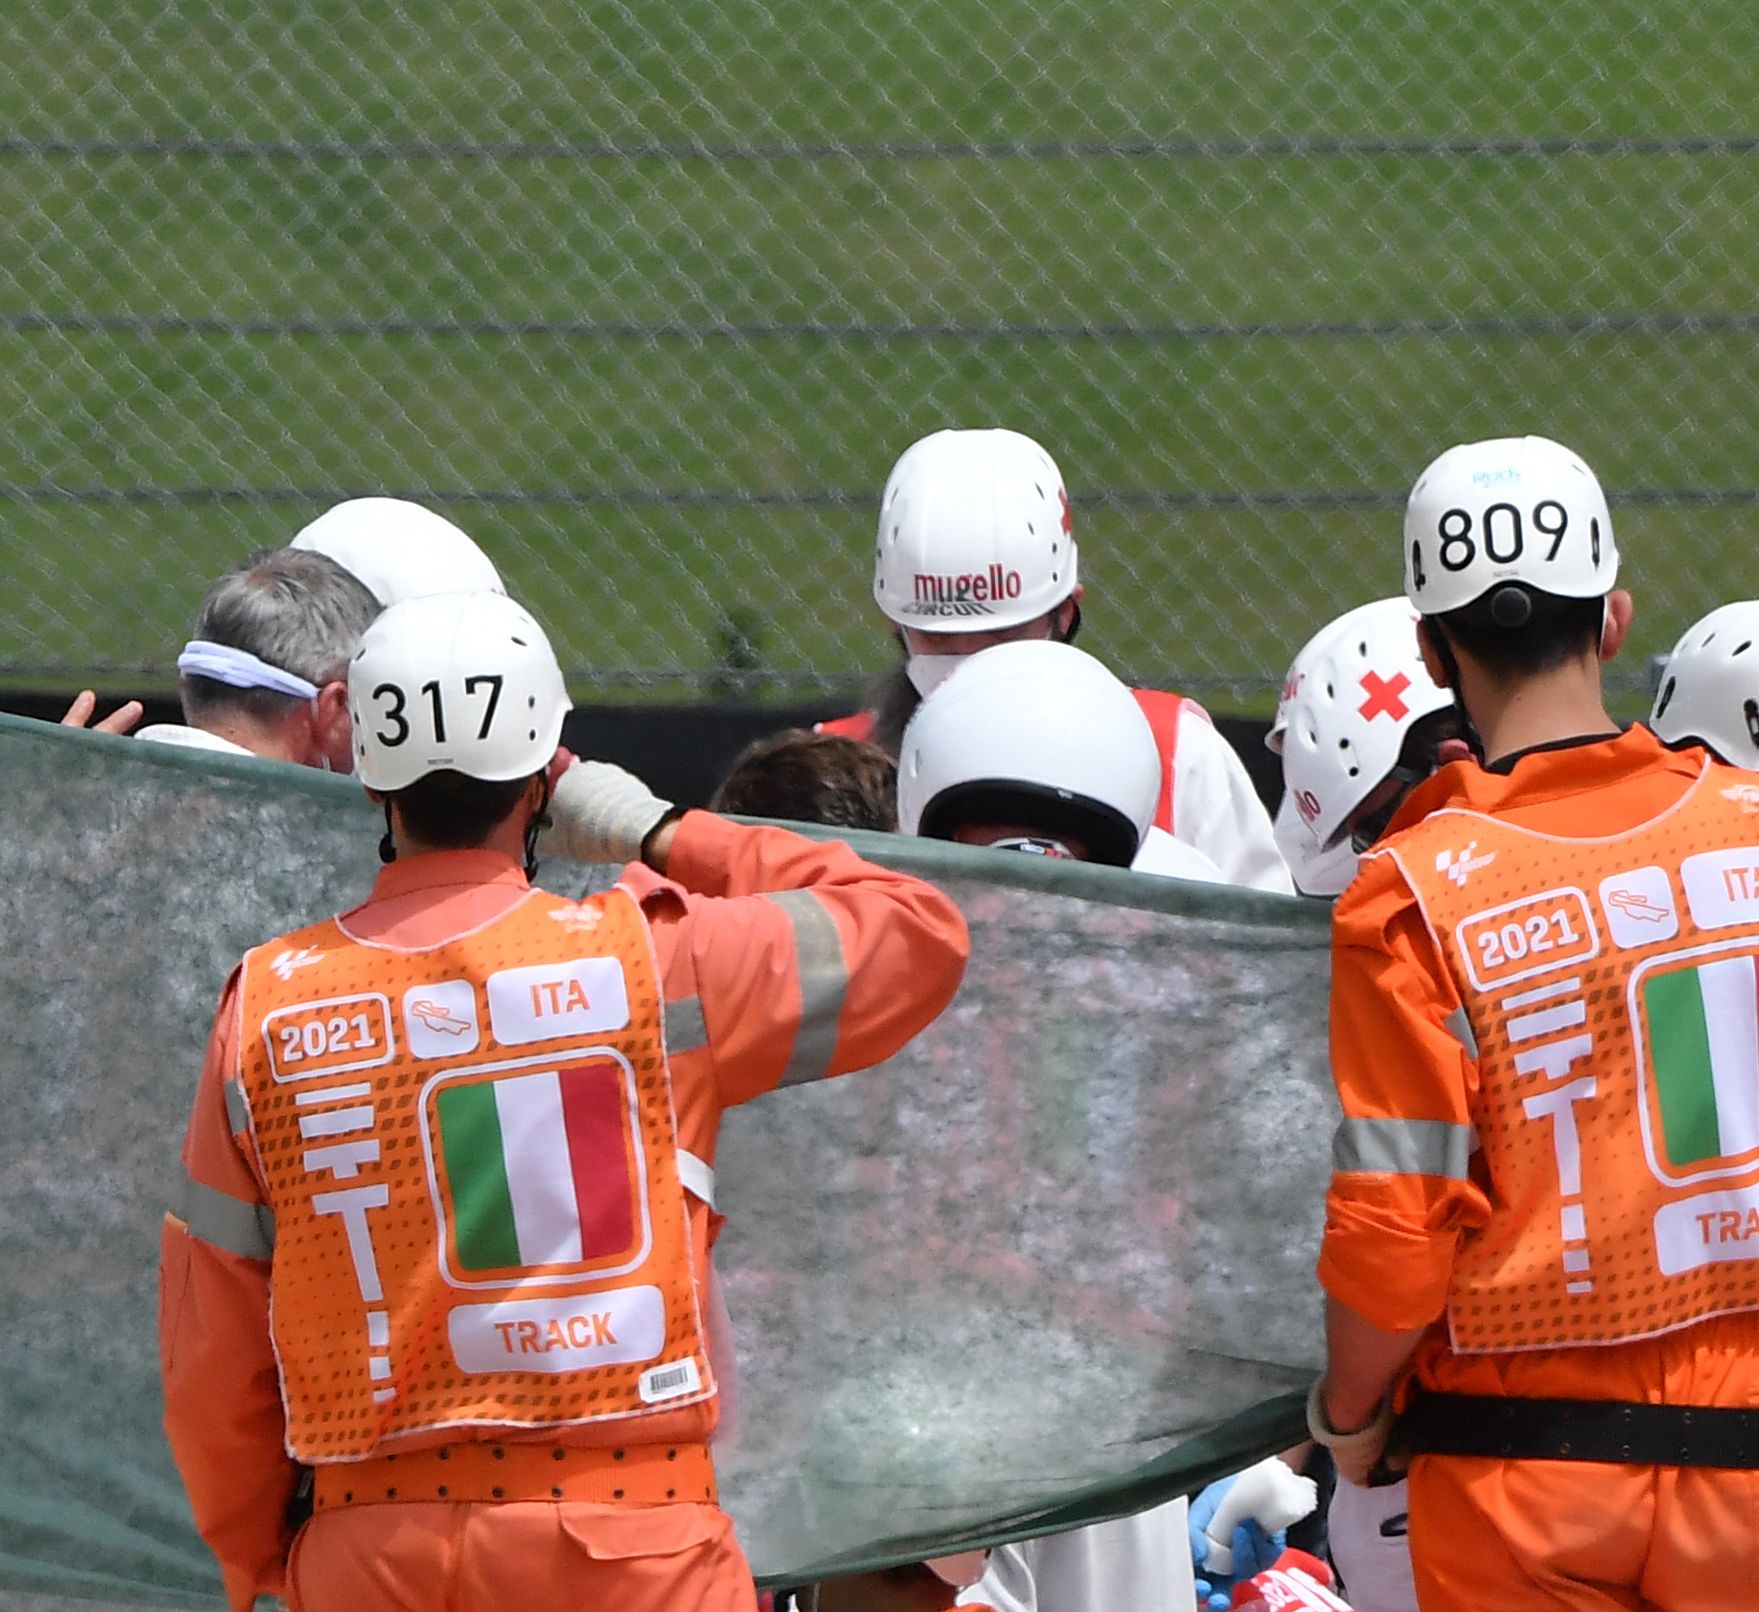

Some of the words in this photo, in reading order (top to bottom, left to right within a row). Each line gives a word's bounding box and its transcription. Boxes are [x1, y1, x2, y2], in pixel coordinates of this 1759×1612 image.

[1438, 499, 1568, 572] 809
[914, 563, 1021, 602] mugello
[371, 674, 504, 748] 317
[1477, 908, 1578, 969] 2021
[529, 978, 591, 1018] ITA
[280, 1014, 375, 1063] 2021
[494, 1312, 616, 1354] TRACK
